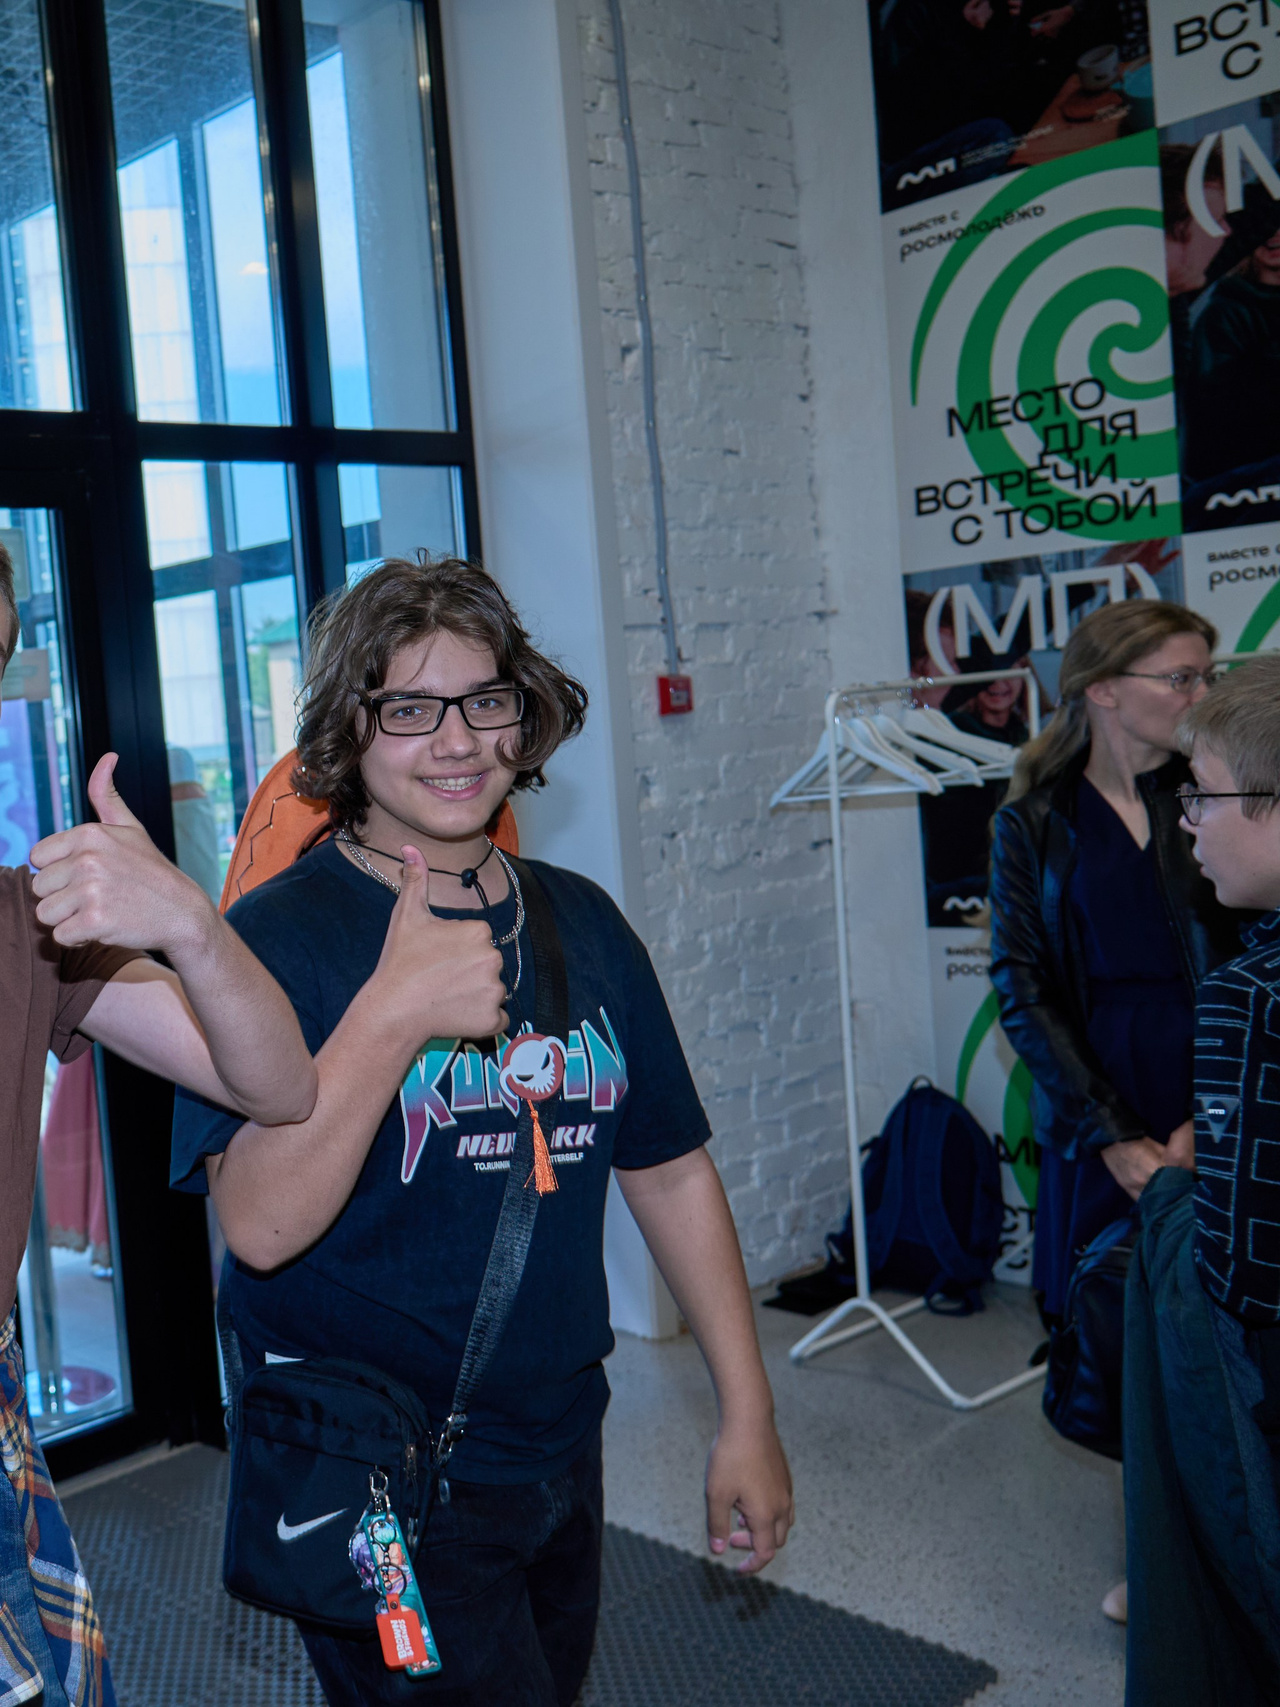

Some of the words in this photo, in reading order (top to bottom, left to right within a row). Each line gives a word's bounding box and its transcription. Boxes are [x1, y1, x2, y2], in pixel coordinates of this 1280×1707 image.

[899, 213, 947, 237] вместе
[946, 377, 1106, 437] МЕСТО
[1039, 409, 1138, 469] ДЛЯ
[915, 453, 1118, 516] ВСТРЕЧИ
[951, 515, 983, 546] С
[994, 479, 1158, 538] ТОБОЙ
[1207, 545, 1270, 563] вместе
[1209, 564, 1280, 592] росм
